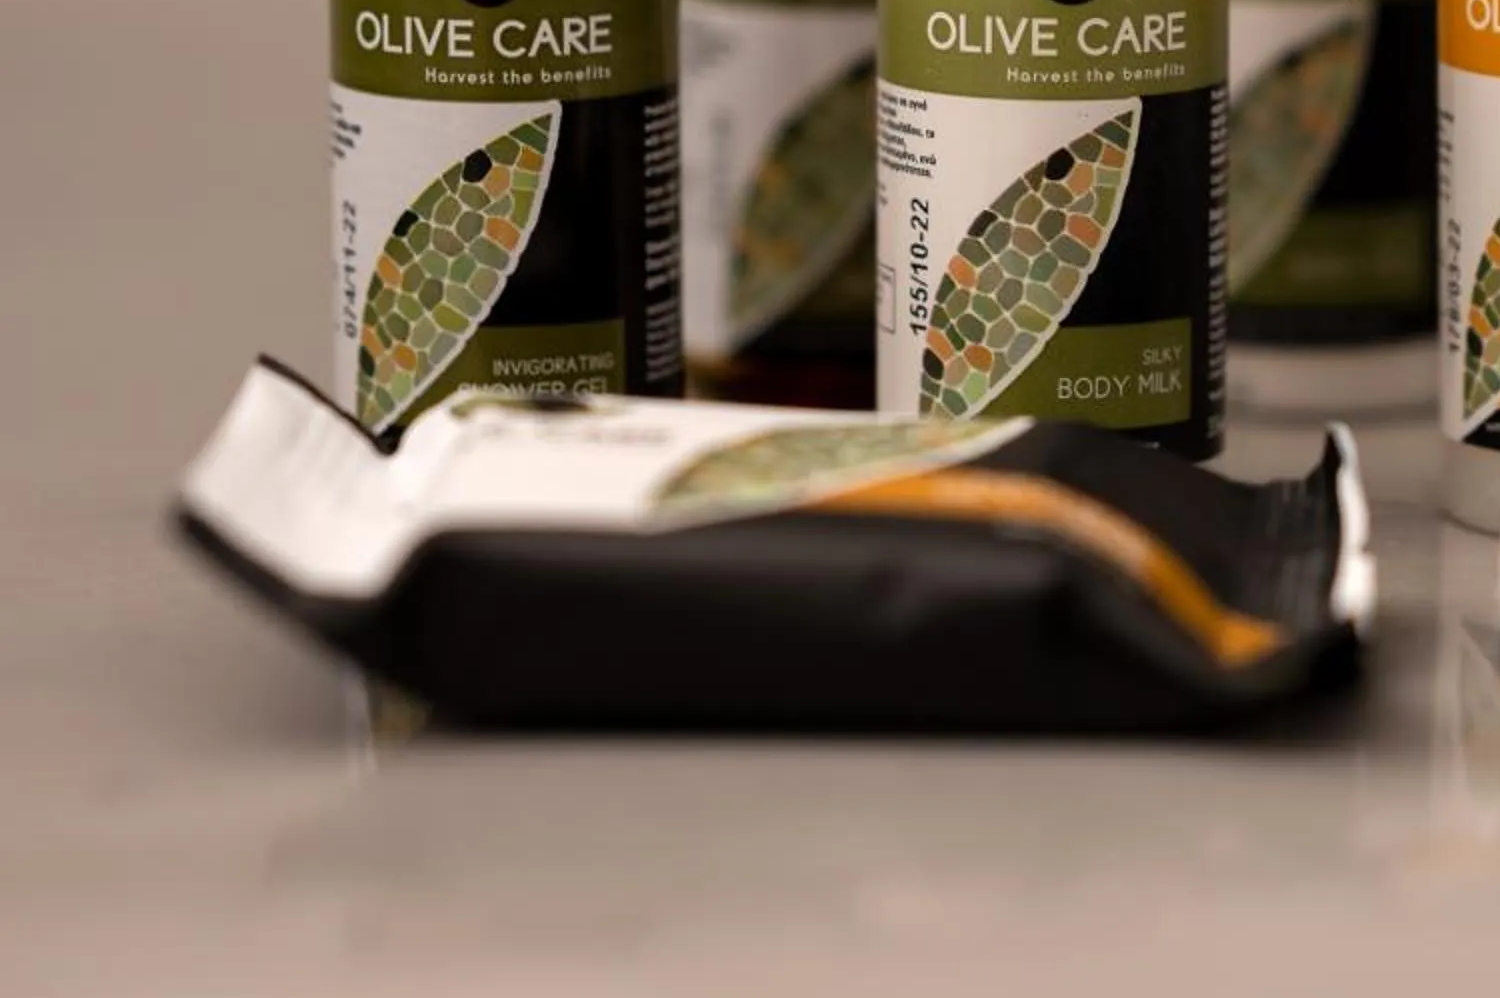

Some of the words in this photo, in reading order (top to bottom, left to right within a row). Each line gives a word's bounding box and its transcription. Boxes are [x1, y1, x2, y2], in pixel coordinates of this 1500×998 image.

[356, 10, 475, 58] OLIVE
[492, 13, 612, 58] CARE
[927, 11, 1058, 57] OLIVE
[1077, 11, 1187, 57] CARE
[424, 66, 494, 85] Harvest
[502, 67, 533, 84] the
[541, 64, 613, 84] benefits
[1006, 66, 1078, 84] Harvest
[1086, 66, 1115, 83] the
[1123, 63, 1186, 82] benefits
[909, 197, 930, 336] 155/10-22
[492, 352, 615, 376] INVIGORATING
[1143, 346, 1182, 365] SILKY
[1057, 375, 1130, 399] BODY
[1138, 370, 1182, 394] MILK
